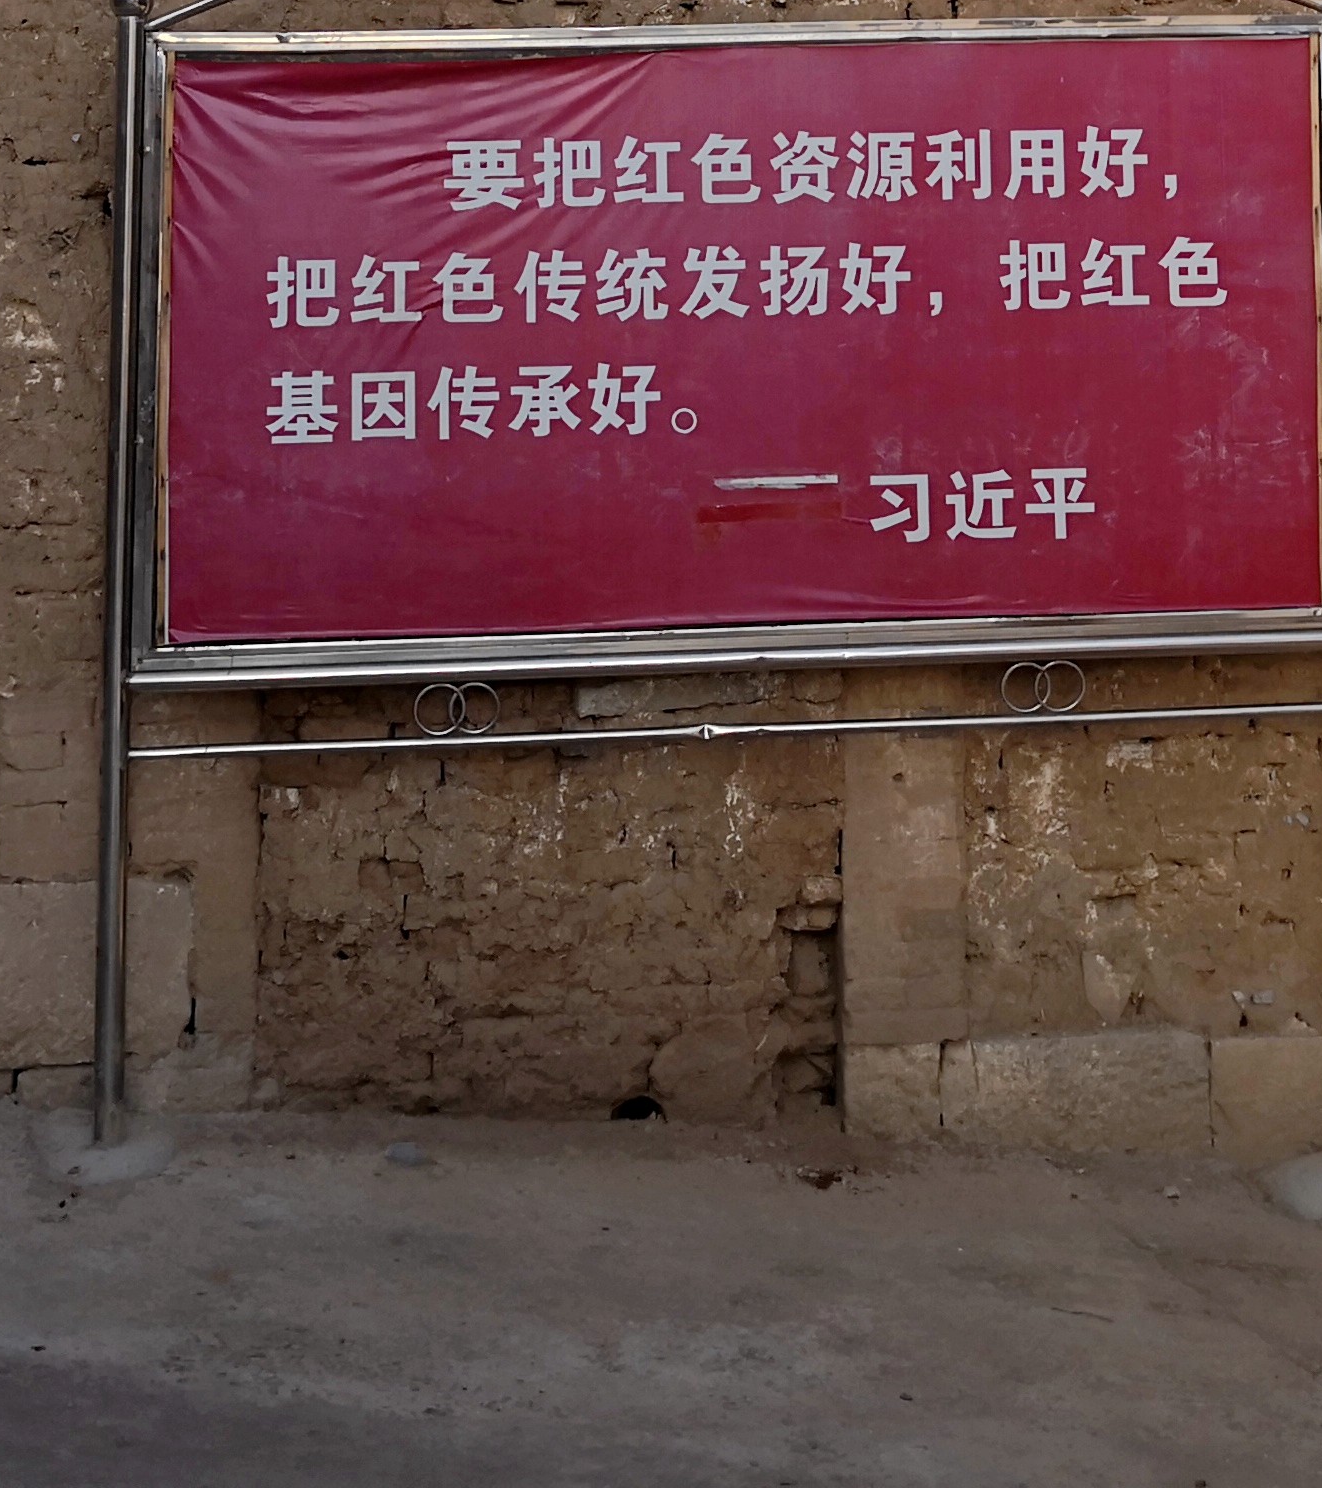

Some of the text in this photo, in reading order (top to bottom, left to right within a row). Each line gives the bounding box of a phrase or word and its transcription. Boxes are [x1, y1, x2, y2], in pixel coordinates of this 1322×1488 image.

[443, 125, 1184, 212] 要把红色资源利用好，
[265, 362, 698, 445] 基因传承好。
